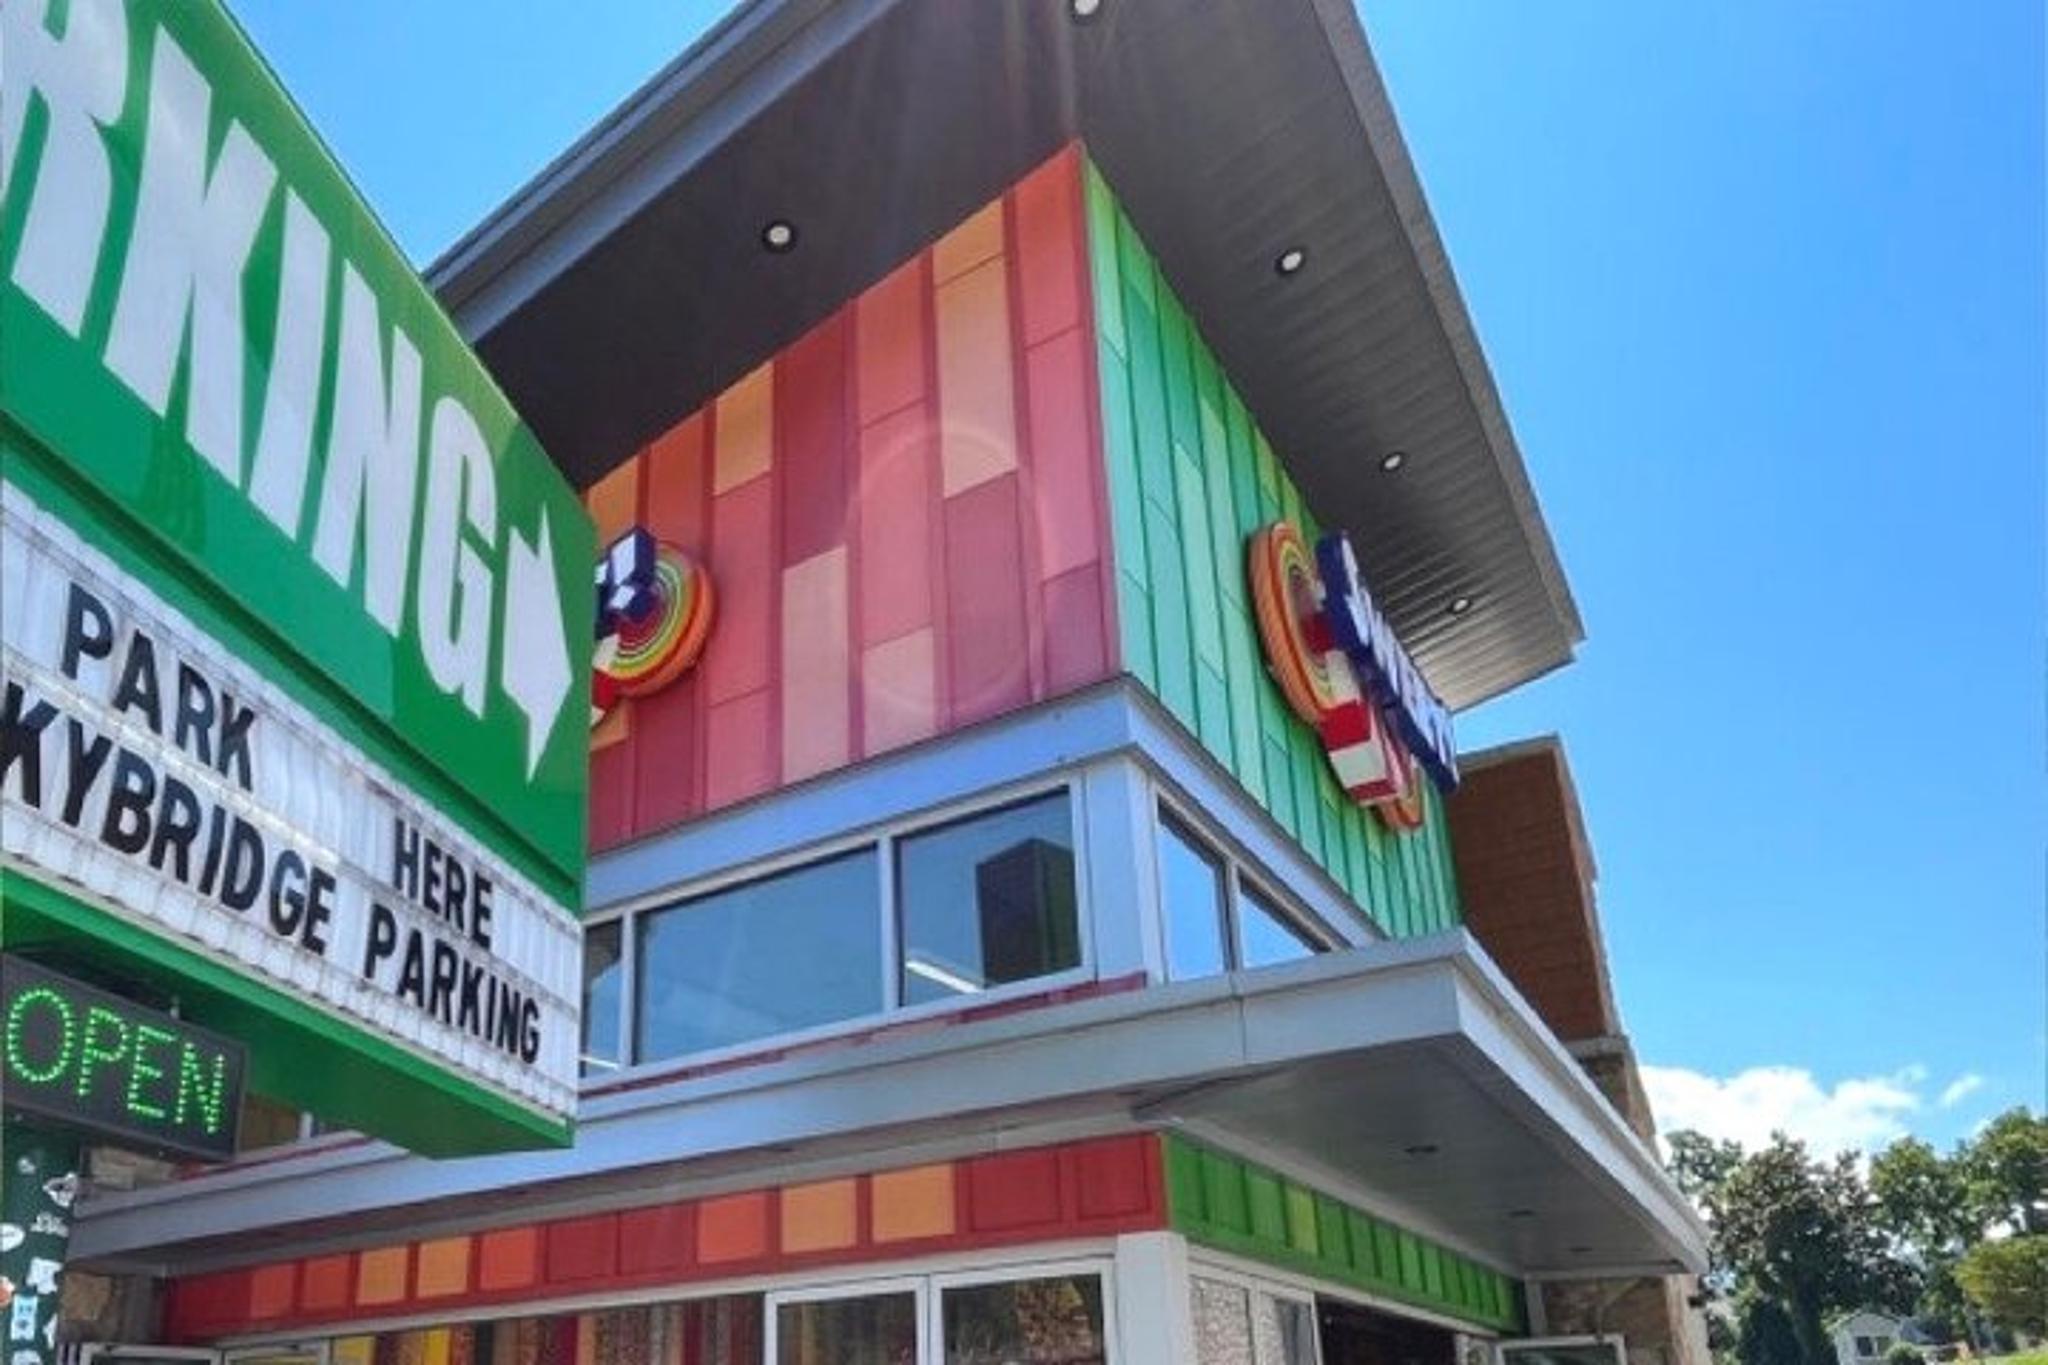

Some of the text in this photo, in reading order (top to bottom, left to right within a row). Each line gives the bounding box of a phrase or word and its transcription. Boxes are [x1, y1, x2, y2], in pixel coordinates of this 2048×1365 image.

[61, 581, 492, 951] PARK HERE
[7, 988, 225, 1134] OPEN
[363, 902, 540, 1064] PARKING
